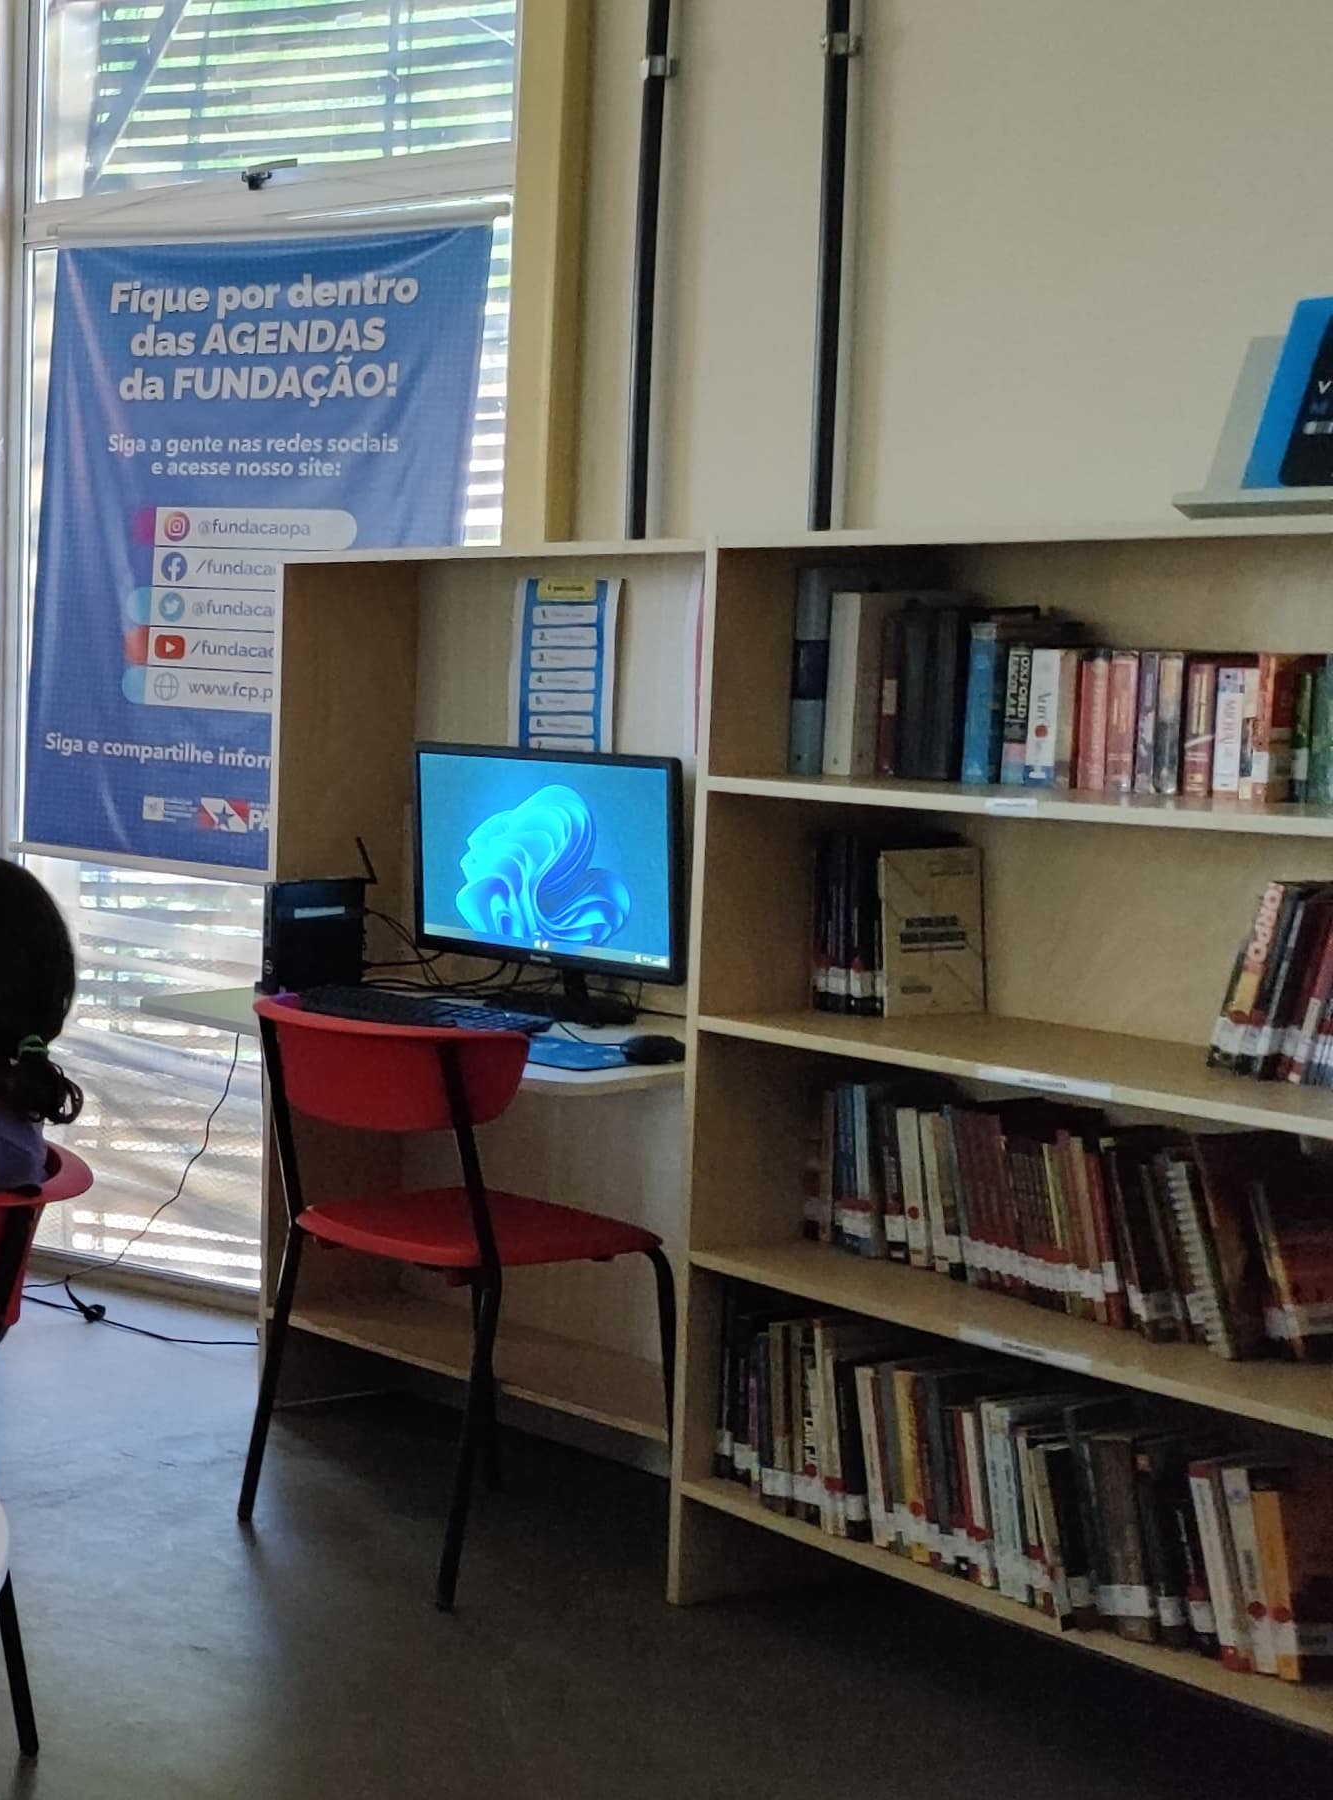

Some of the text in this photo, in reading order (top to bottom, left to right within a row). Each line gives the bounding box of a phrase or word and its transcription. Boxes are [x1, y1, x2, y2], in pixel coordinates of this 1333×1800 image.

[109, 273, 419, 322] Fique por dentro
[130, 317, 386, 358] das AGENDAS
[119, 356, 398, 407] da FUNDAÇÃO!
[107, 433, 399, 459] Siga a gente nas redes sociais
[151, 457, 342, 477] e acesse nosso site:
[197, 519, 311, 538] @fundacaopa
[195, 559, 276, 577] /fundaca
[192, 599, 275, 618] @fundaca
[1017, 656, 1031, 719] OXFORD
[44, 732, 84, 756] Siga
[87, 740, 99, 754] e
[102, 741, 214, 766] compartilhe
